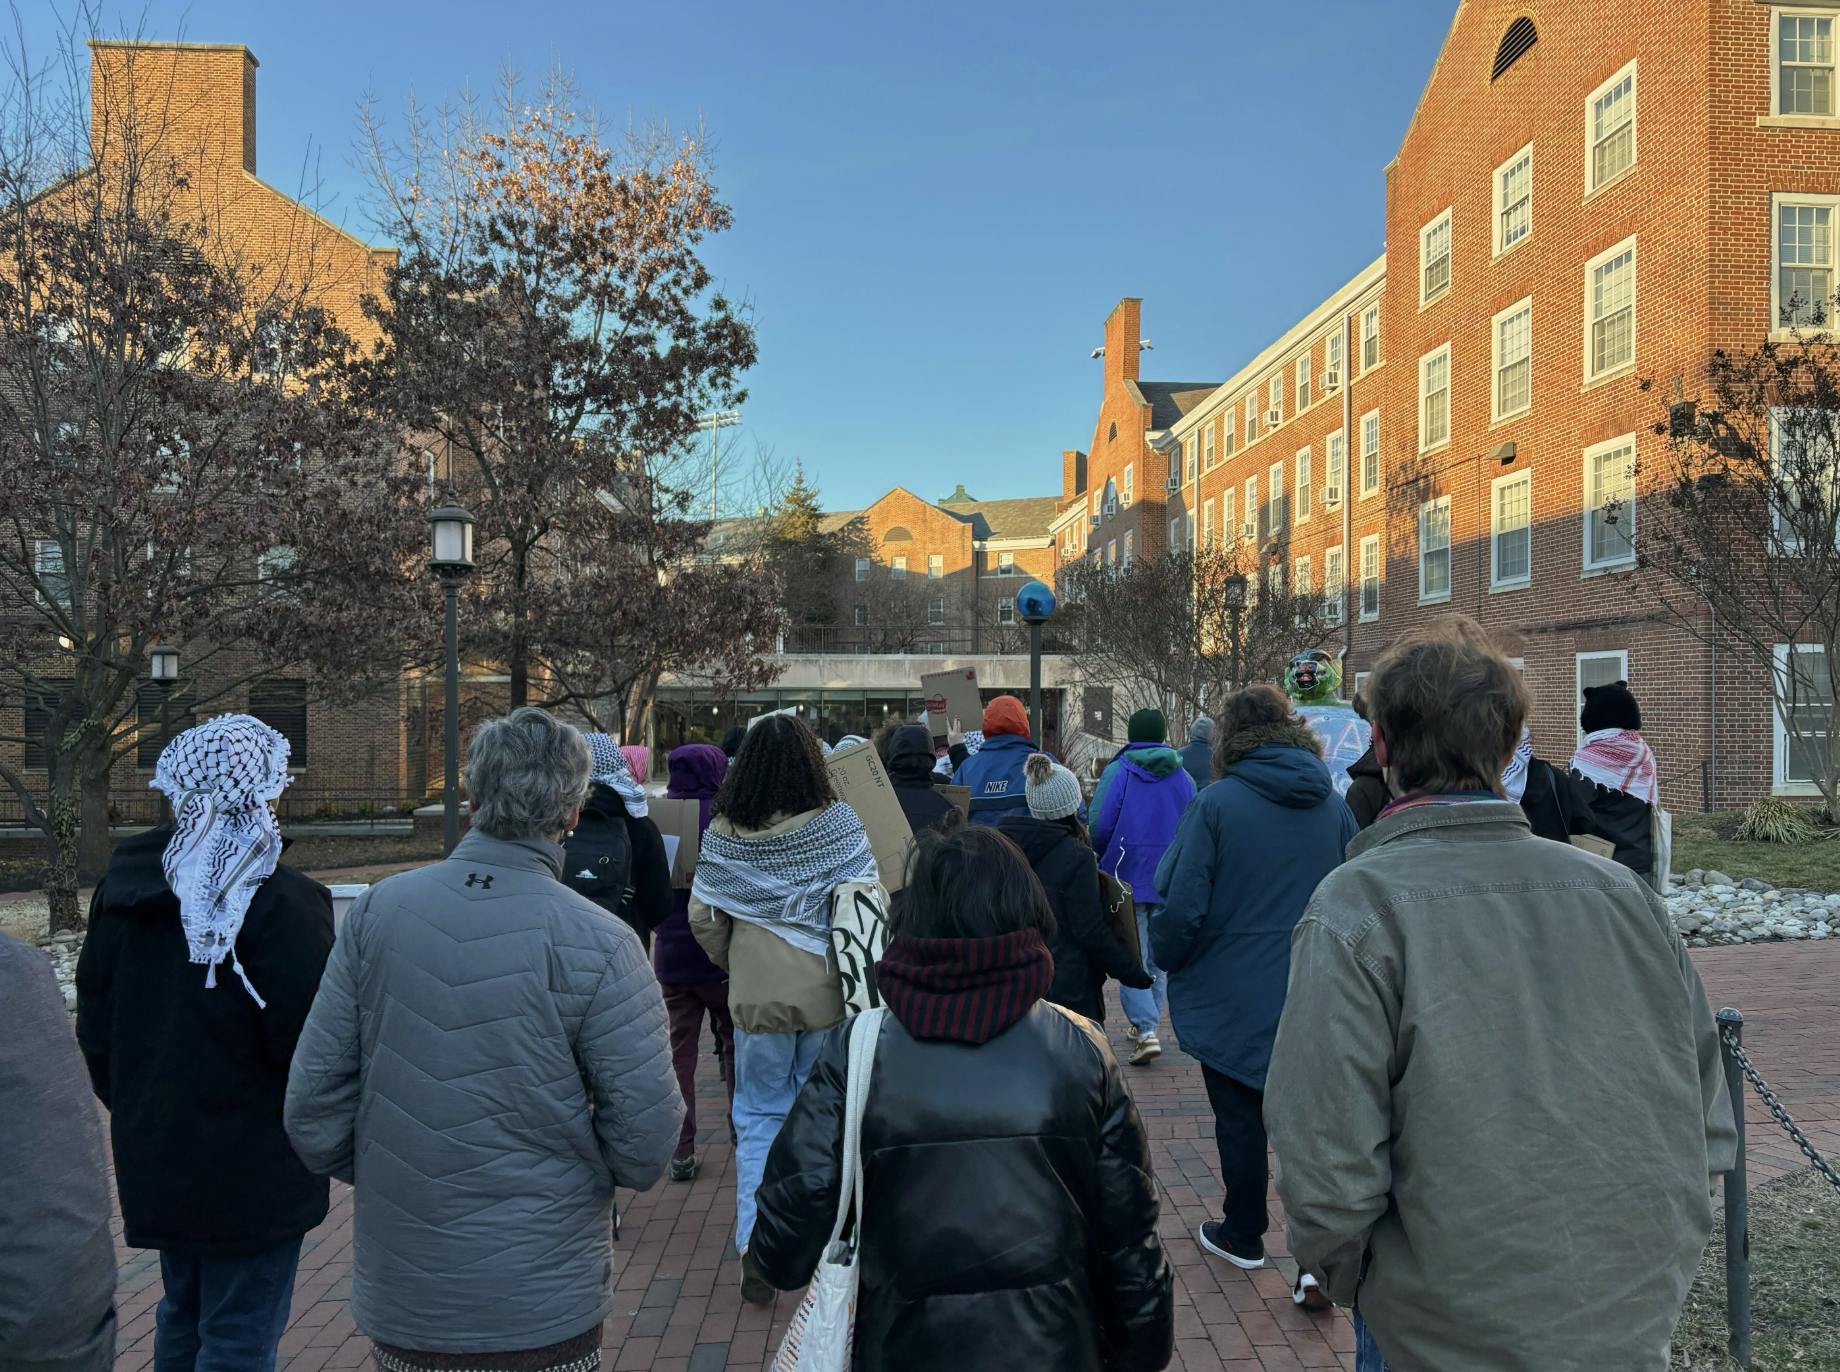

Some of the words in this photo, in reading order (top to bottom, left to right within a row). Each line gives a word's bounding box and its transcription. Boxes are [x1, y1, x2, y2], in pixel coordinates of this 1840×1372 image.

[866, 755, 879, 776] GC20
[874, 777, 885, 788] NT
[984, 780, 1008, 793] NIKE
